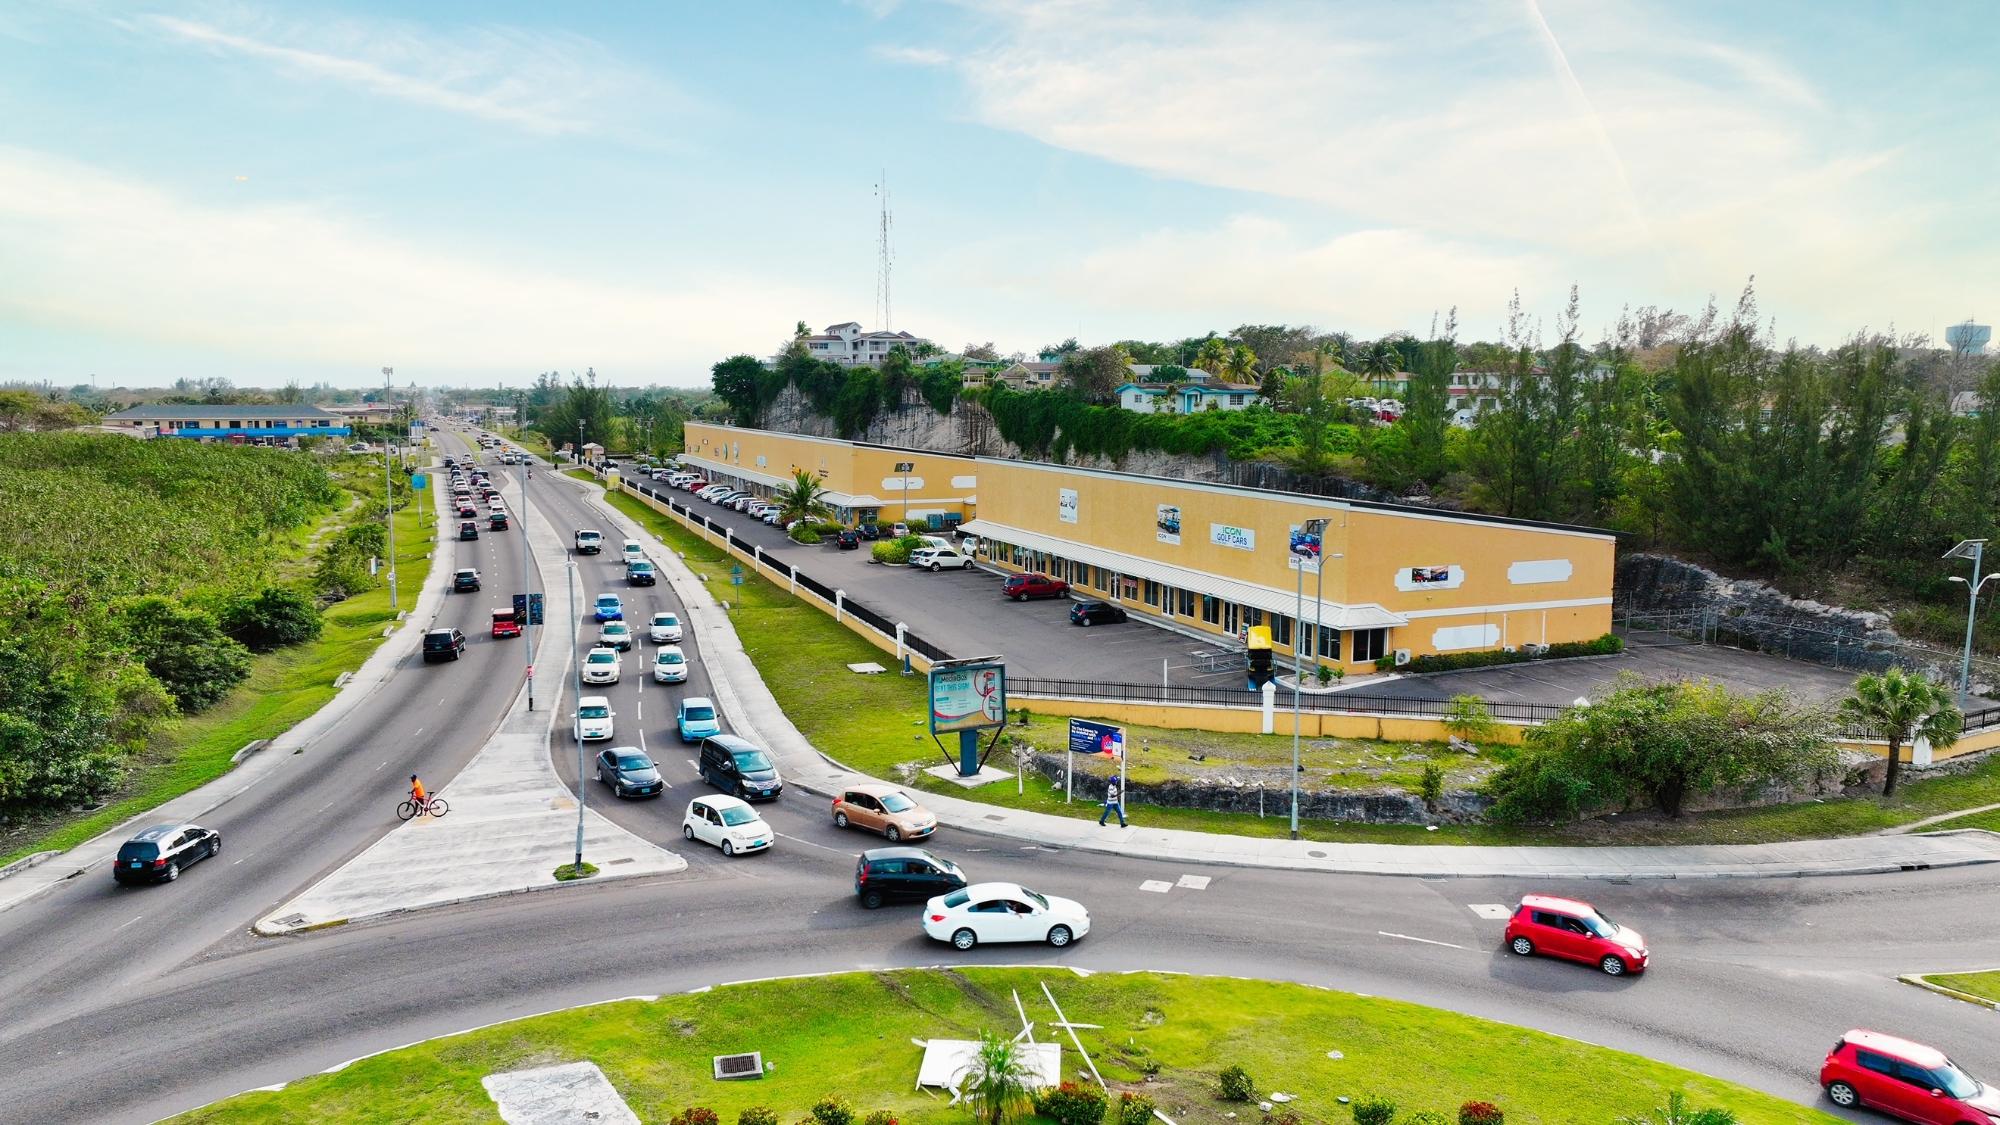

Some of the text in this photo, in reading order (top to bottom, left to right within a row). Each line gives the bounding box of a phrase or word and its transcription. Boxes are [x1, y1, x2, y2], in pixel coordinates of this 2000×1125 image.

[1222, 526, 1242, 536] ICON
[1216, 533, 1231, 542] GOLF
[1232, 535, 1248, 545] CARS
